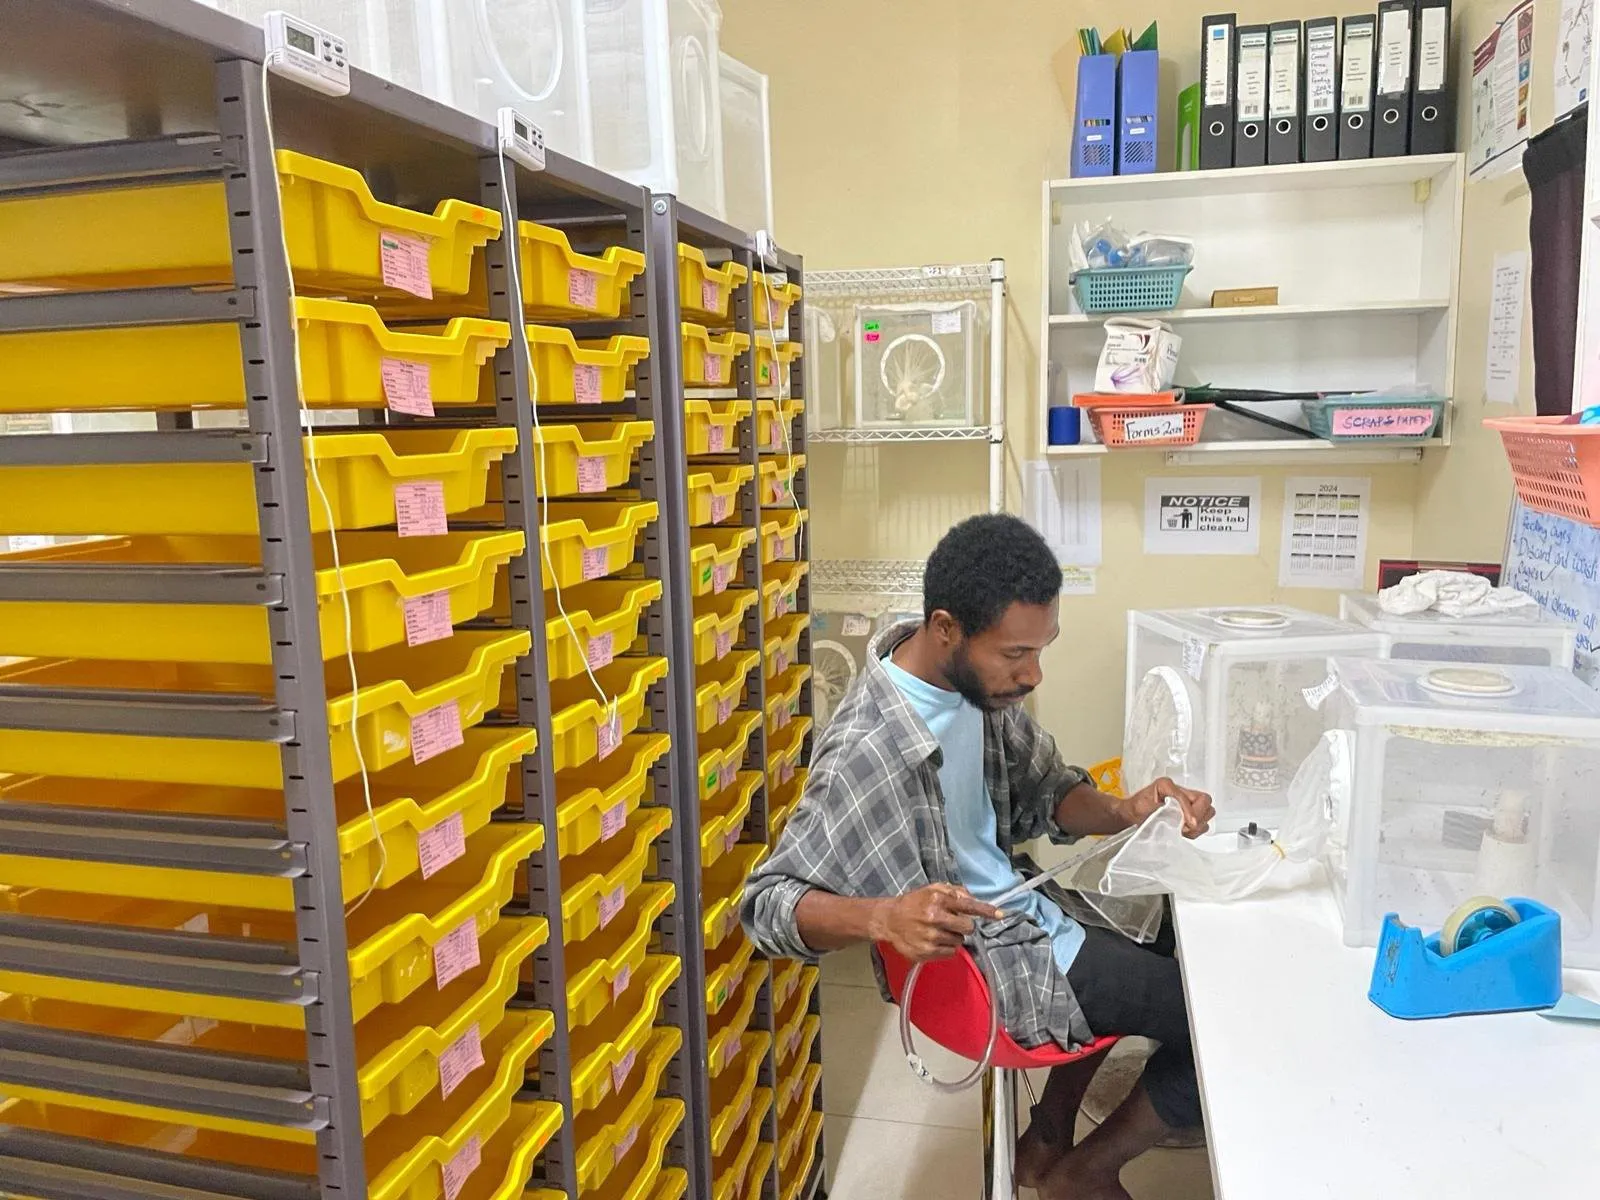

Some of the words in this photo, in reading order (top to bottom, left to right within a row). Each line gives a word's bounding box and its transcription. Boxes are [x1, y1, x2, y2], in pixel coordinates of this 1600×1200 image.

[1126, 421, 1160, 440] Forms
[1169, 497, 1242, 506] NOTICE
[1200, 507, 1232, 515] Keep
